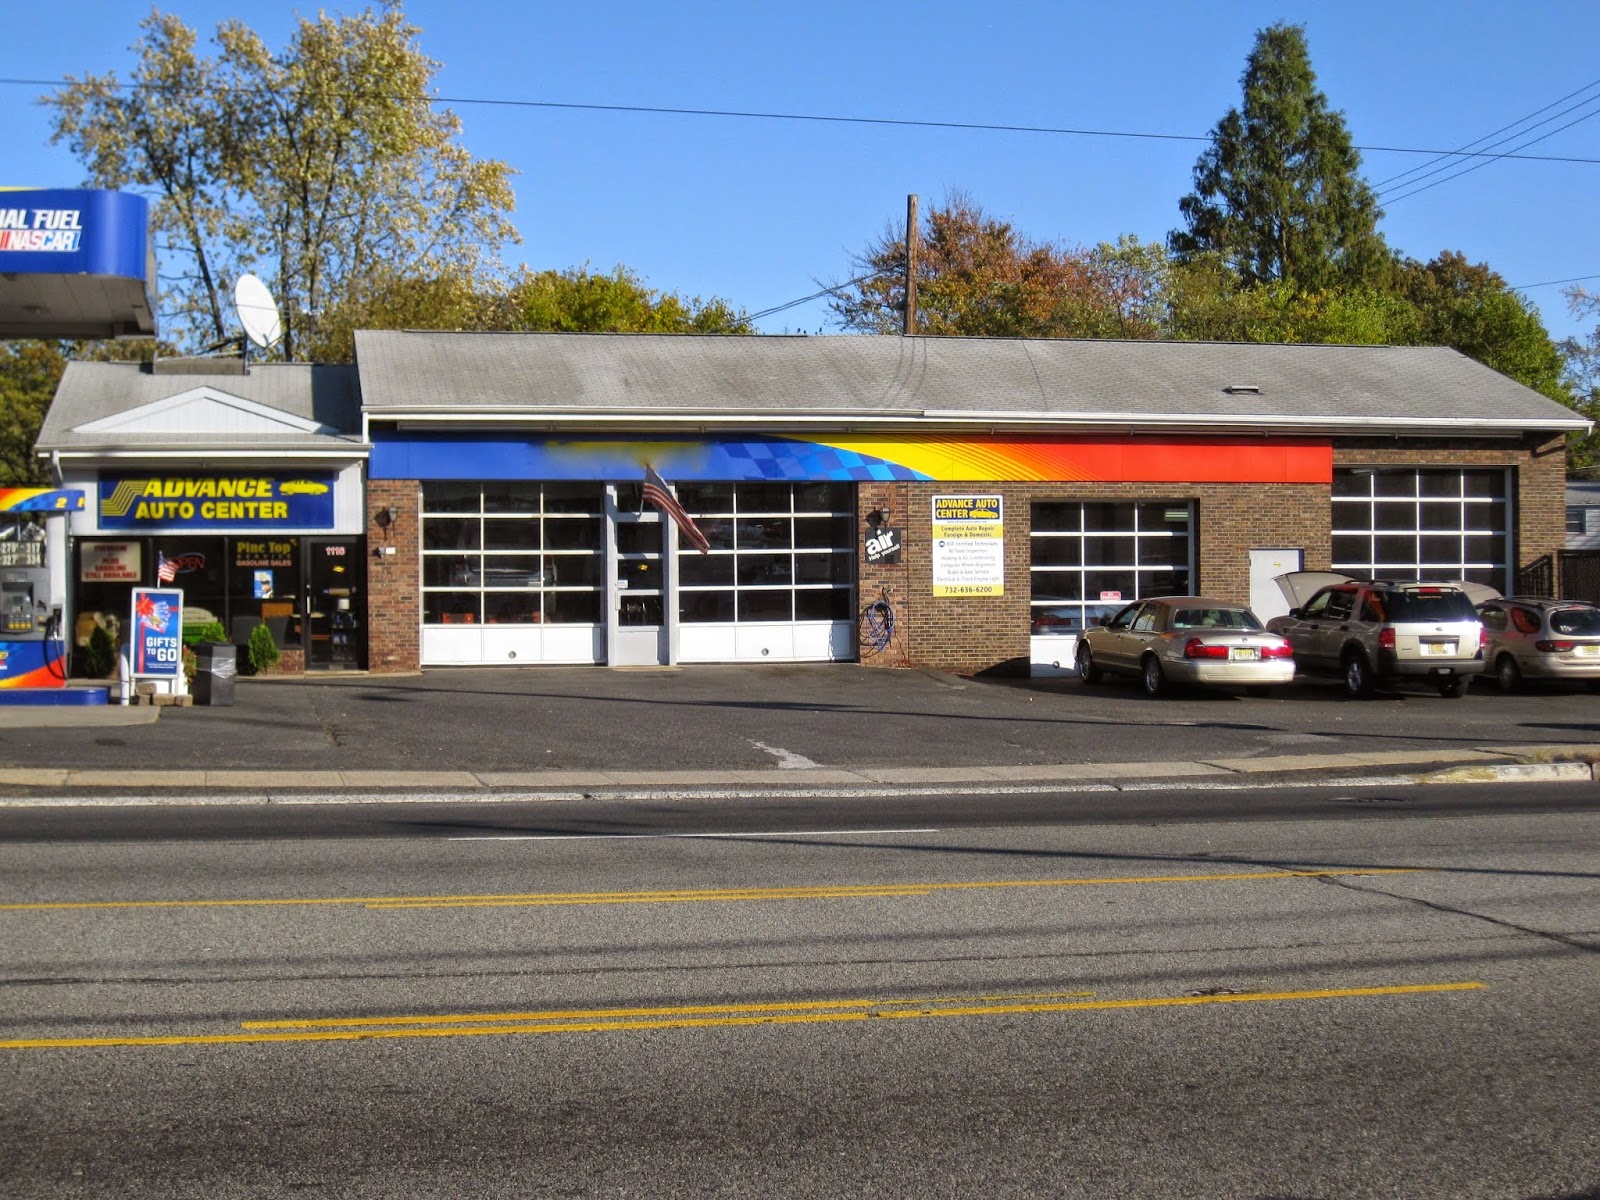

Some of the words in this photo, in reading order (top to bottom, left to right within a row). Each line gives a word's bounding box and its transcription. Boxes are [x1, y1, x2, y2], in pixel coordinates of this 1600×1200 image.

[32, 209, 82, 229] FUEL
[9, 230, 76, 250] NASCAR
[143, 478, 273, 498] ADVANCE
[55, 496, 67, 508] 2
[936, 499, 973, 508] ADVANCE
[976, 499, 998, 508] AUTO
[135, 502, 194, 519] AUTO
[200, 502, 288, 519] CENTER
[936, 509, 969, 518] CENTER
[268, 542, 291, 554] Top
[866, 529, 894, 555] air
[236, 559, 269, 567] GASOLINE
[270, 559, 292, 567] SALES
[146, 637, 177, 648] GIFTS
[157, 648, 177, 662] GO
